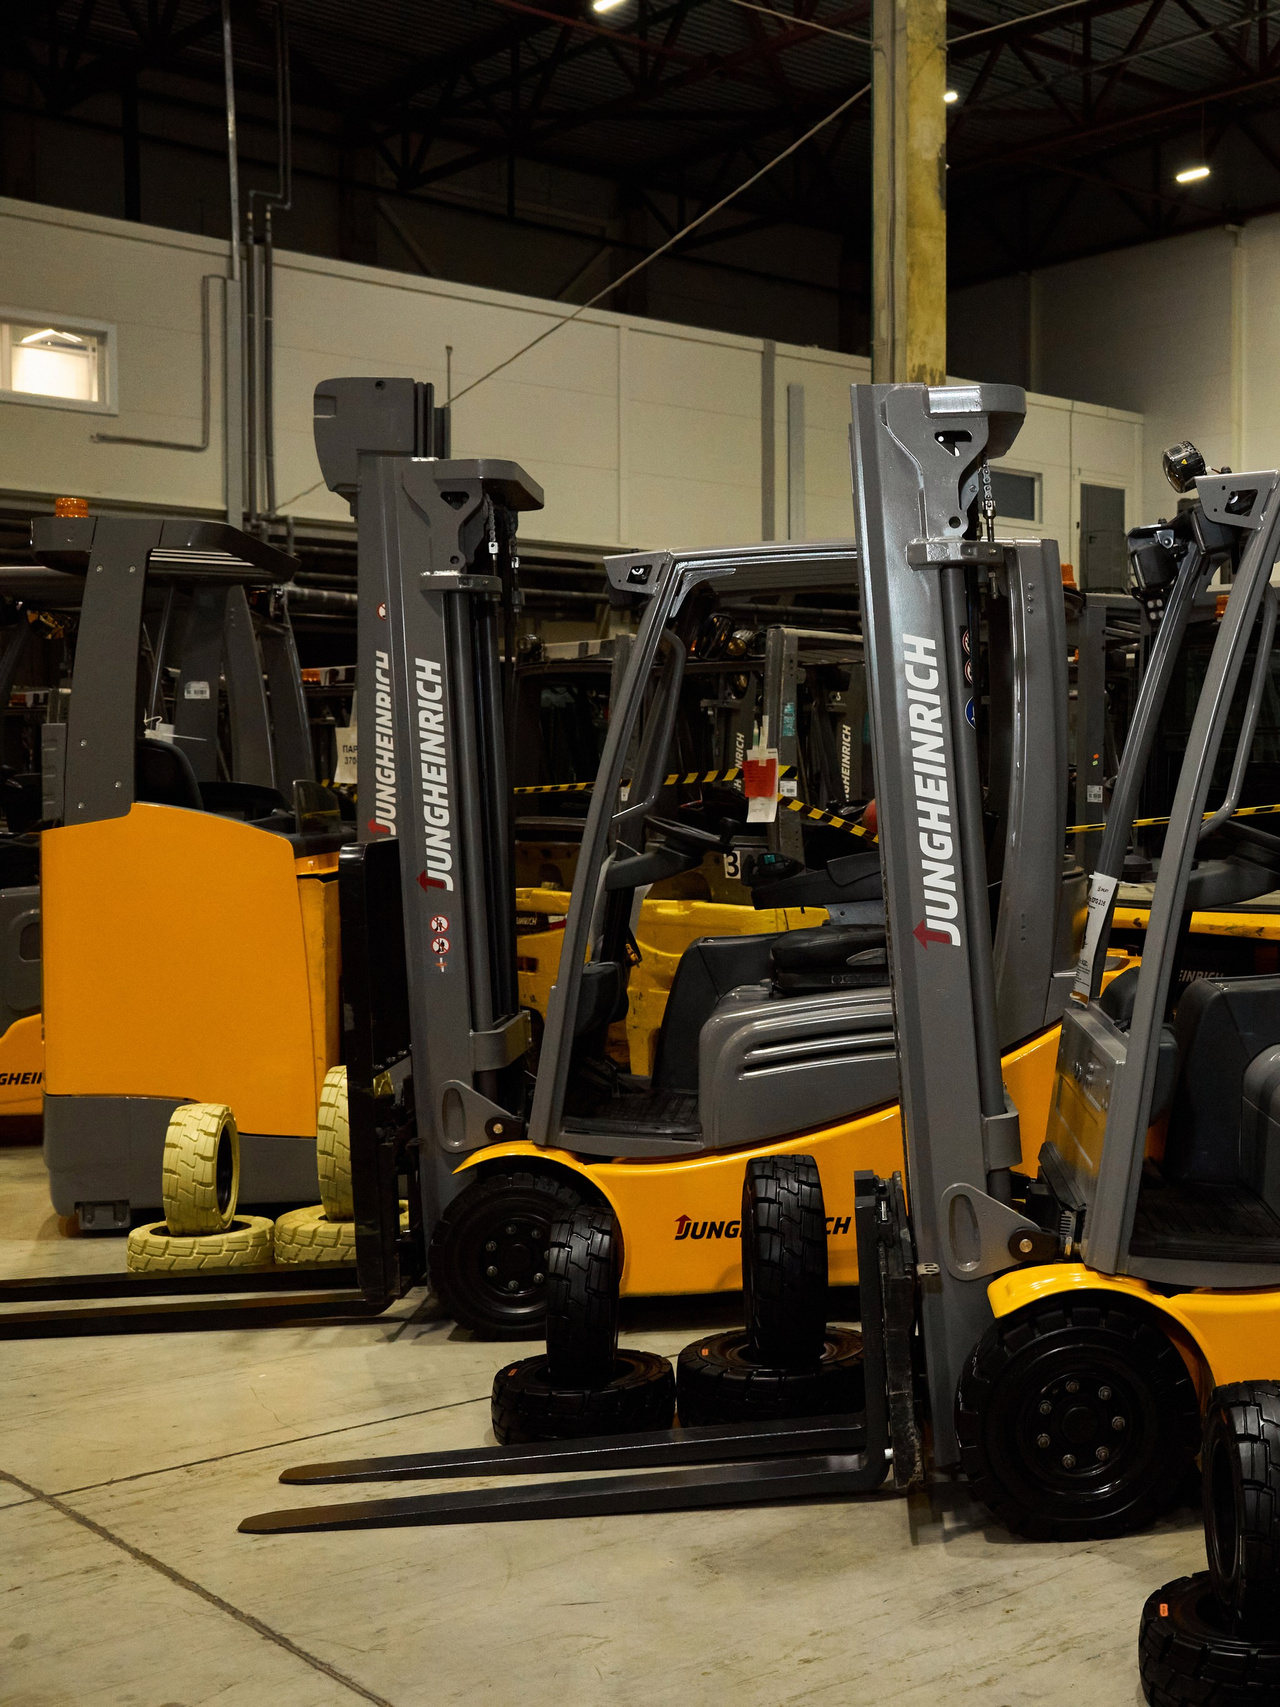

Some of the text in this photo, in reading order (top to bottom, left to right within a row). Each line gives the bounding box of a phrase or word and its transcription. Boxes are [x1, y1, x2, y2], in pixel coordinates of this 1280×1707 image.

[414, 657, 454, 892] JUNGHEINRICH
[726, 852, 740, 877] 3
[902, 632, 962, 947] JUNGHEINRICH
